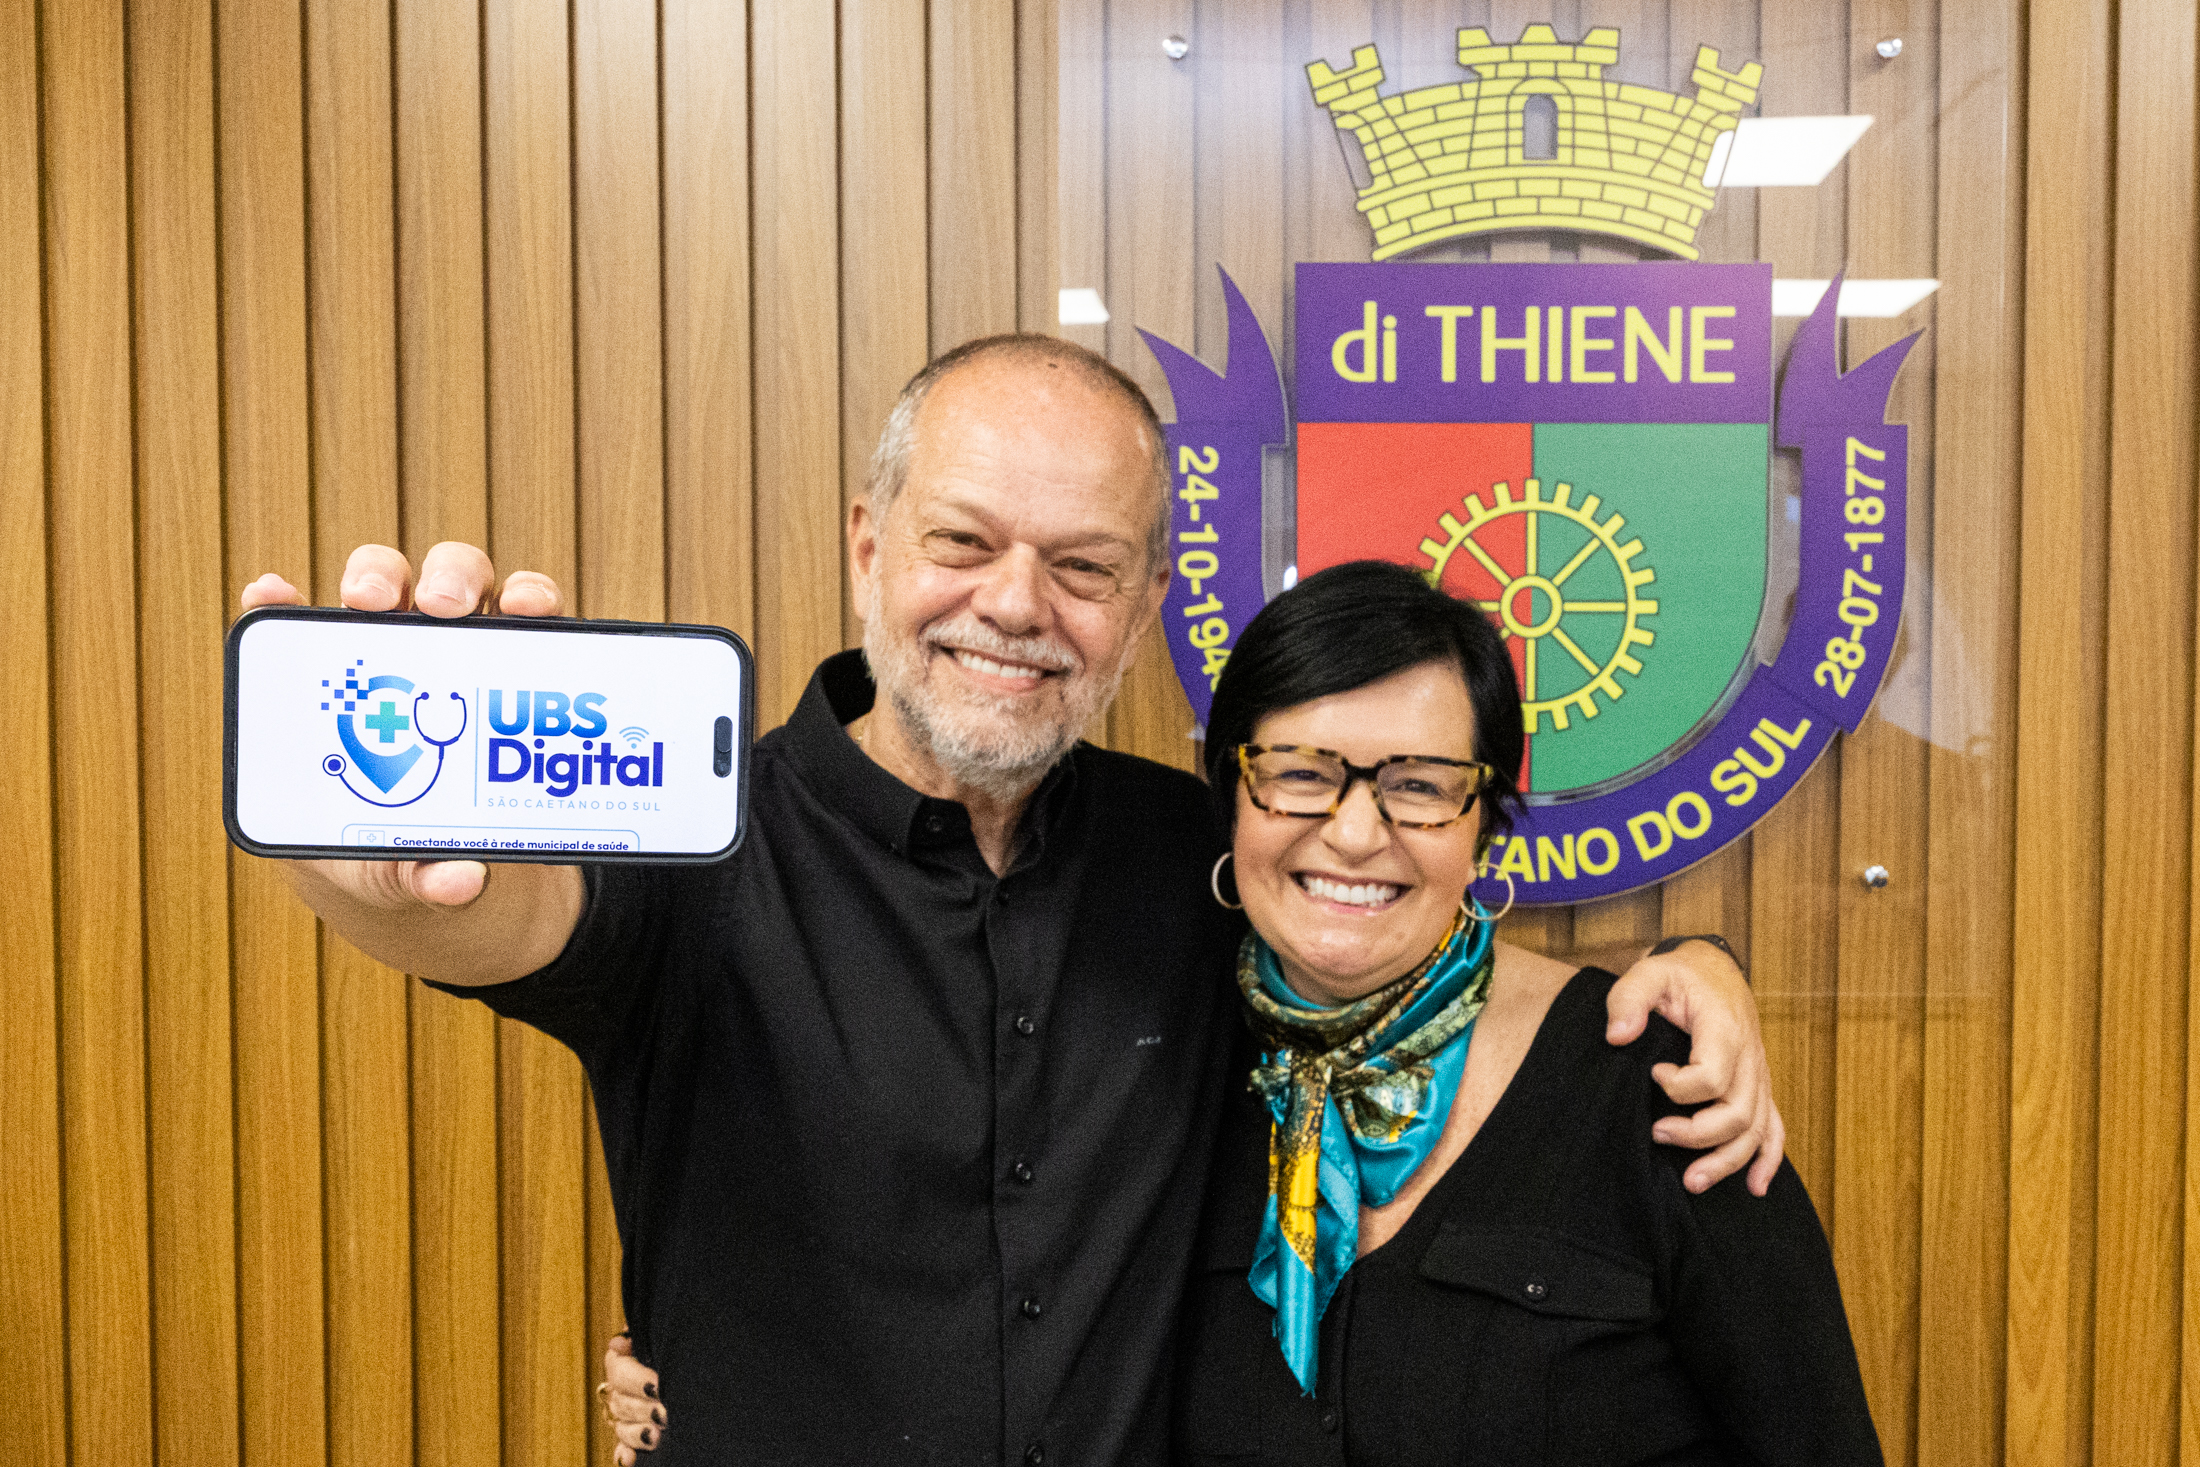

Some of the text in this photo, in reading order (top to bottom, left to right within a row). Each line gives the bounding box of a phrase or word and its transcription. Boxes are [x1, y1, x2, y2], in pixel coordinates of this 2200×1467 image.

[1331, 300, 1737, 383] di THIENE
[1813, 436, 1886, 699] 28-07-1877
[488, 689, 608, 739] UBS
[488, 737, 664, 798] Digital
[1626, 791, 1712, 863] DO
[1710, 717, 1812, 807] SUL
[487, 795, 661, 812] SÃO CAETANO DO SUL
[393, 836, 629, 851] Conectando você à rede municipal de saúde
